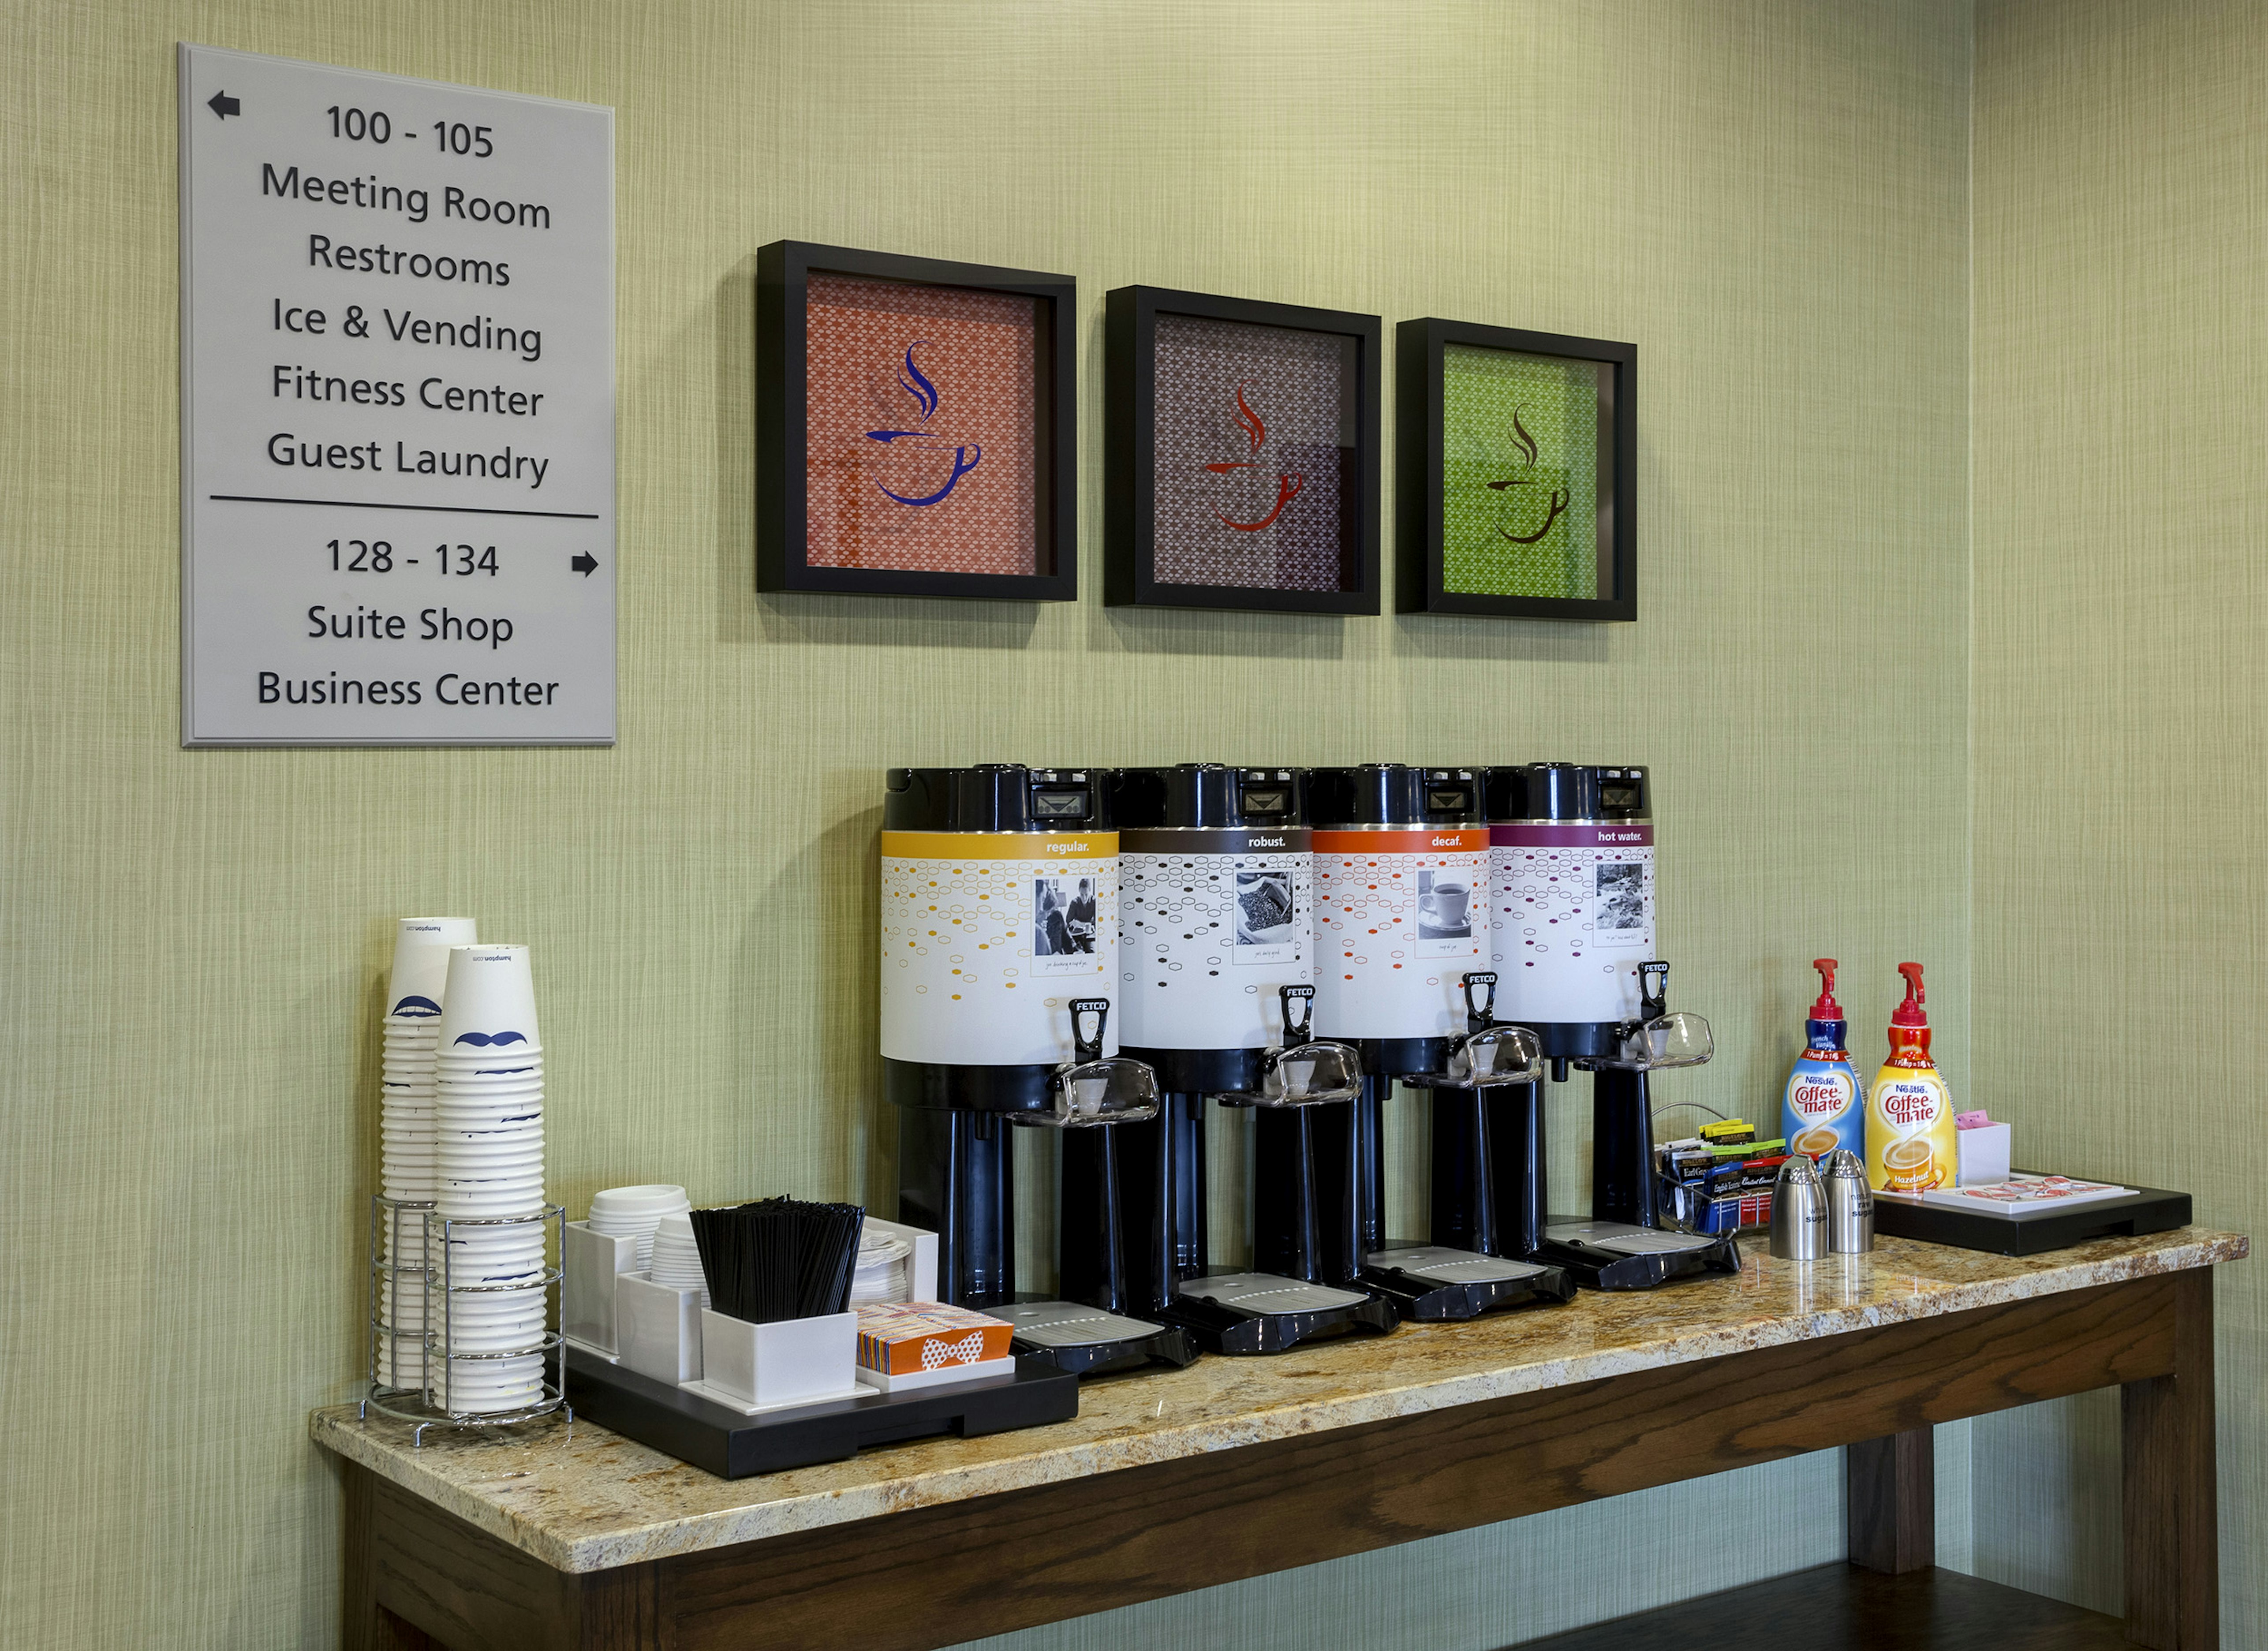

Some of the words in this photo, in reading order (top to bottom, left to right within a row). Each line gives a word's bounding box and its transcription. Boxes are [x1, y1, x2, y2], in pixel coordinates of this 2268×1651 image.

[327, 105, 391, 145] 100
[433, 121, 493, 158] 105
[262, 162, 428, 223] Meeting
[445, 186, 550, 229] Room
[310, 234, 510, 287] Restrooms
[274, 298, 326, 335] Ice
[343, 305, 370, 339] &
[383, 308, 541, 362] Vending
[273, 365, 405, 407] Fitness
[419, 377, 544, 416] Center
[267, 433, 382, 471] Guest
[397, 441, 549, 489] Laundry
[326, 539, 393, 573] 128
[436, 544, 500, 577] 134
[308, 605, 406, 640] Suite
[420, 607, 513, 650] Shop
[258, 671, 422, 705] Business
[435, 673, 560, 706] Center
[1248, 836, 1285, 847] robust.
[1432, 835, 1462, 846] decaf.
[1598, 831, 1616, 841] hot
[1618, 832, 1642, 841] water.
[1046, 840, 1089, 855] regular.
[1469, 975, 1495, 983] FETCO
[1287, 988, 1313, 997] FETCO
[1076, 1001, 1107, 1011] FETCO
[1804, 1099, 1842, 1113] mate
[1896, 1107, 1933, 1124] mate
[1684, 1168, 1695, 1177] Earl
[1894, 1171, 1929, 1184] Hazelnut
